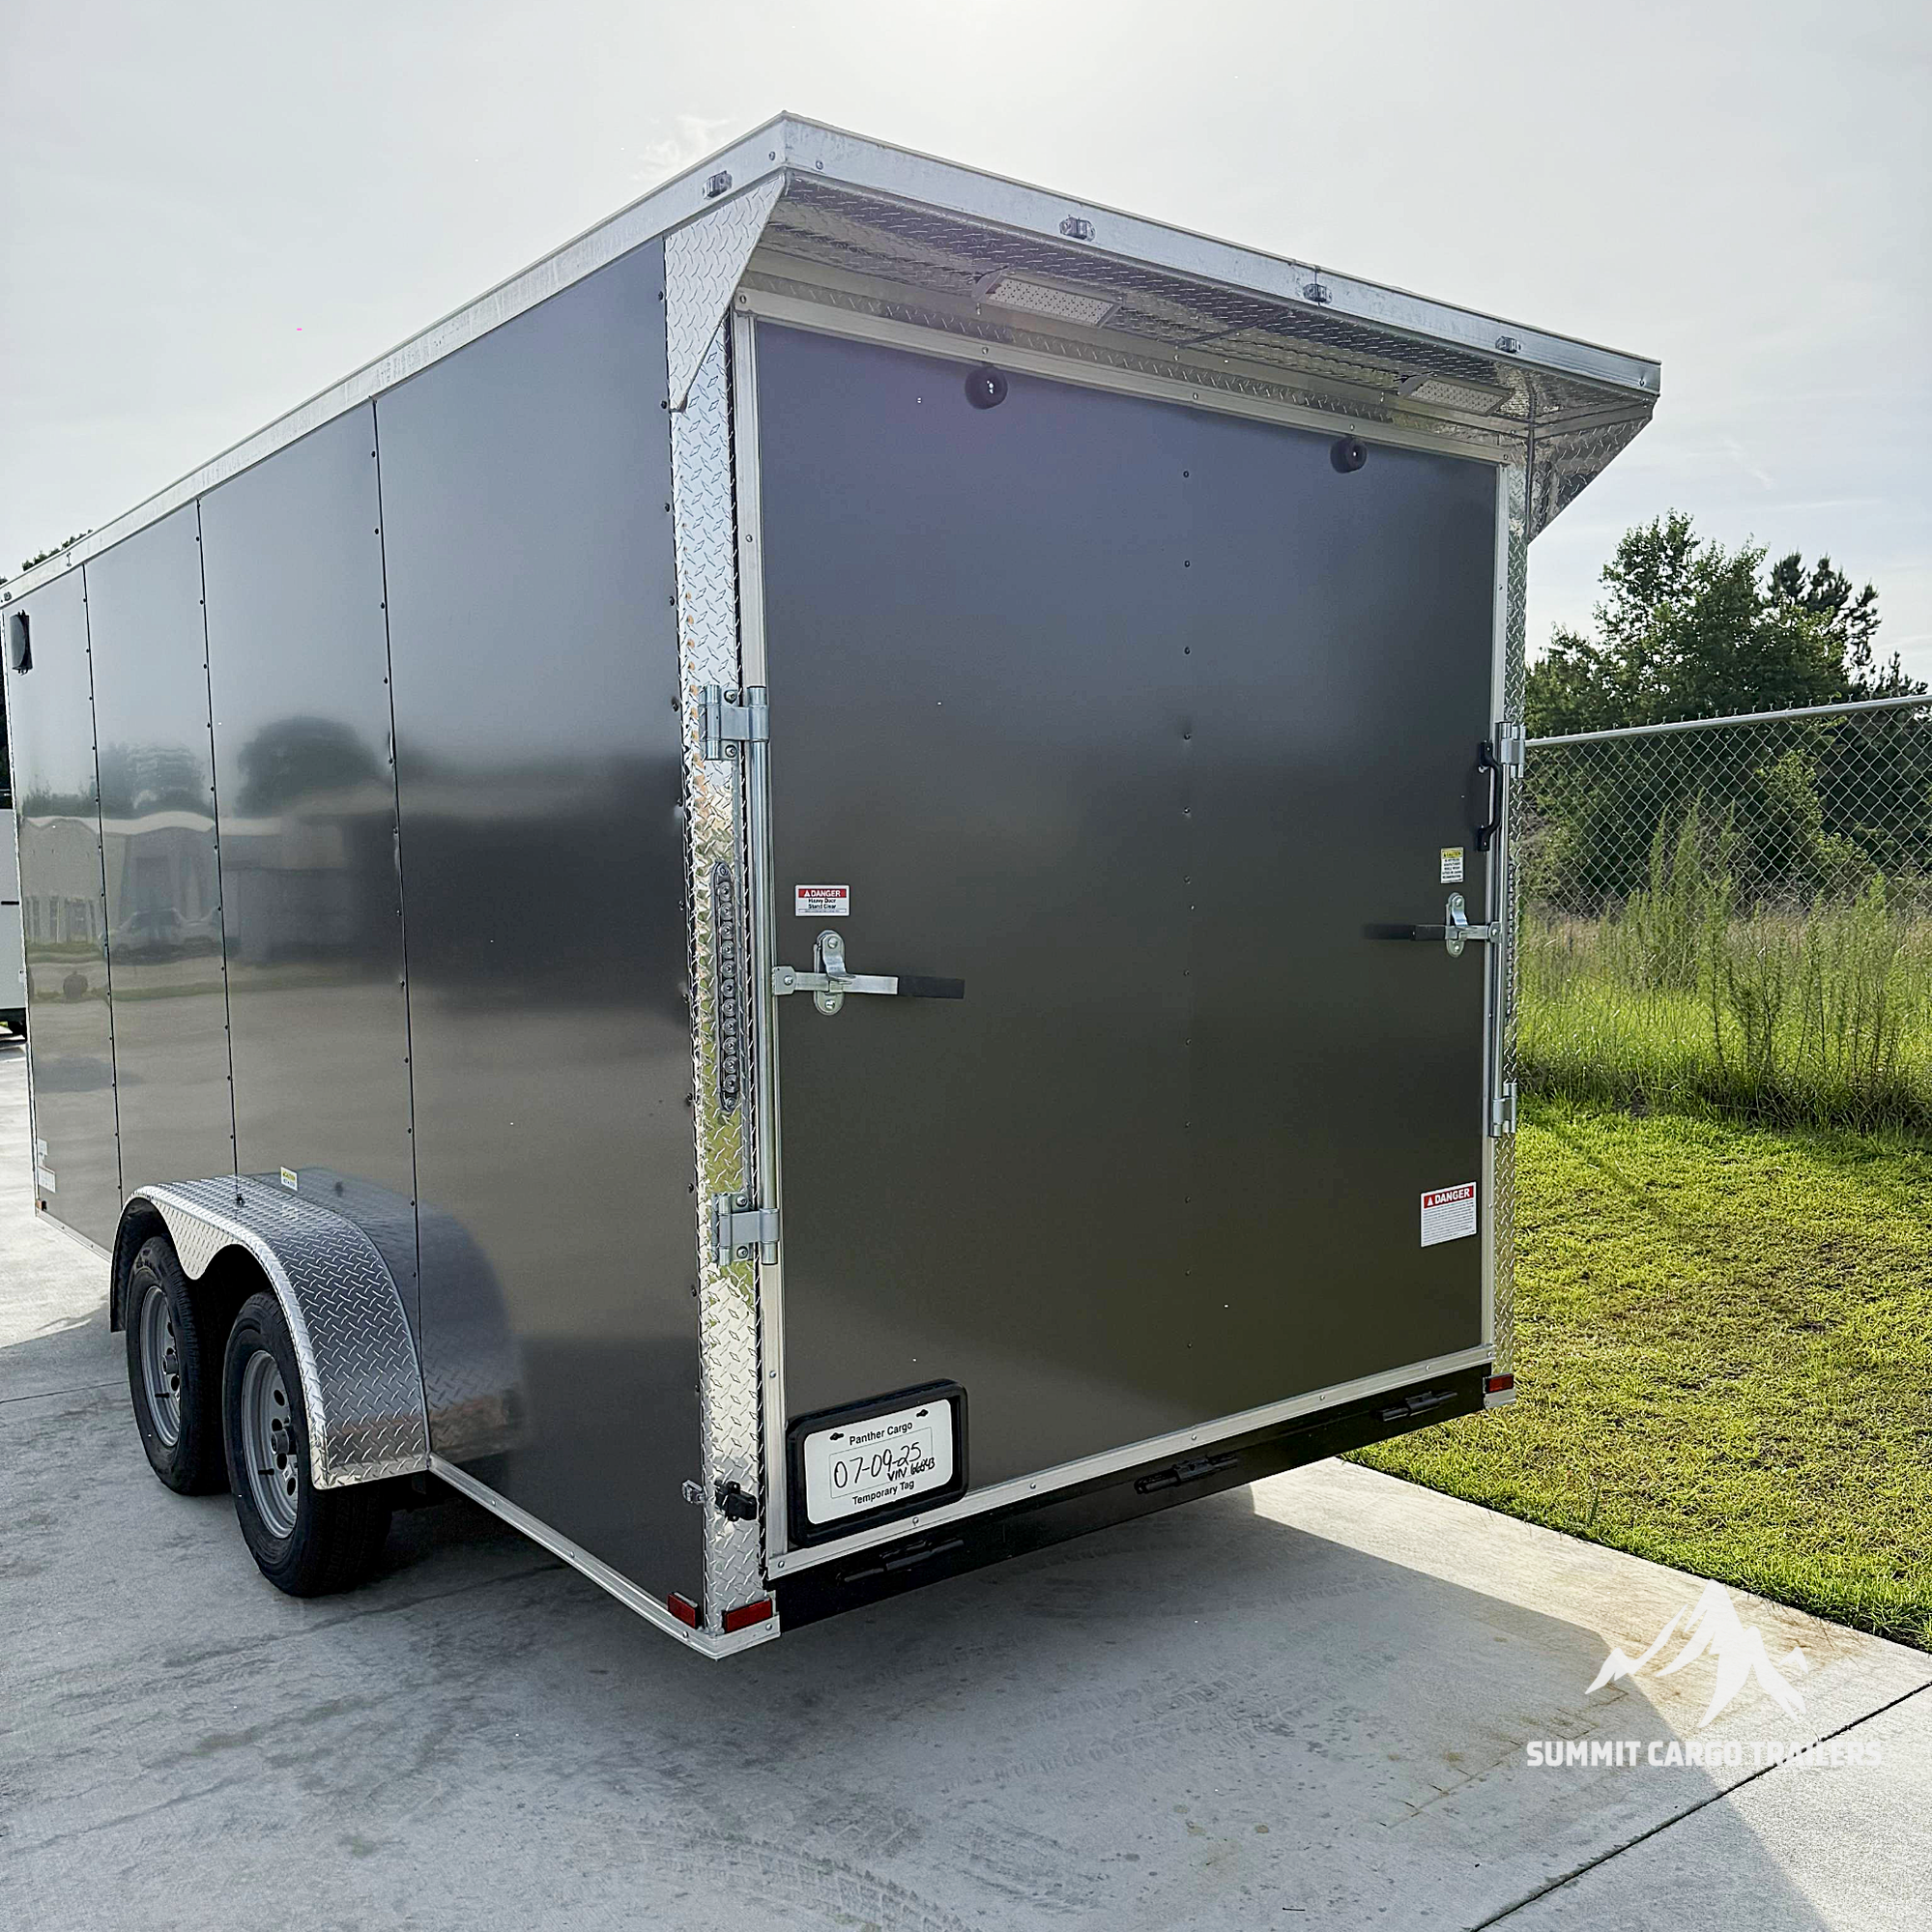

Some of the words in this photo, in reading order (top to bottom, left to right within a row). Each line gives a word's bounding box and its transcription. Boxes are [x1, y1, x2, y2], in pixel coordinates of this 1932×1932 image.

[1434, 1188, 1470, 1204] DANGER
[850, 1428, 885, 1446] Panther
[887, 1422, 913, 1435] Cargo
[834, 1442, 922, 1488] 07-09-25
[887, 1467, 908, 1482] VIN
[852, 1485, 898, 1506] Temporary
[900, 1480, 915, 1490] Tag
